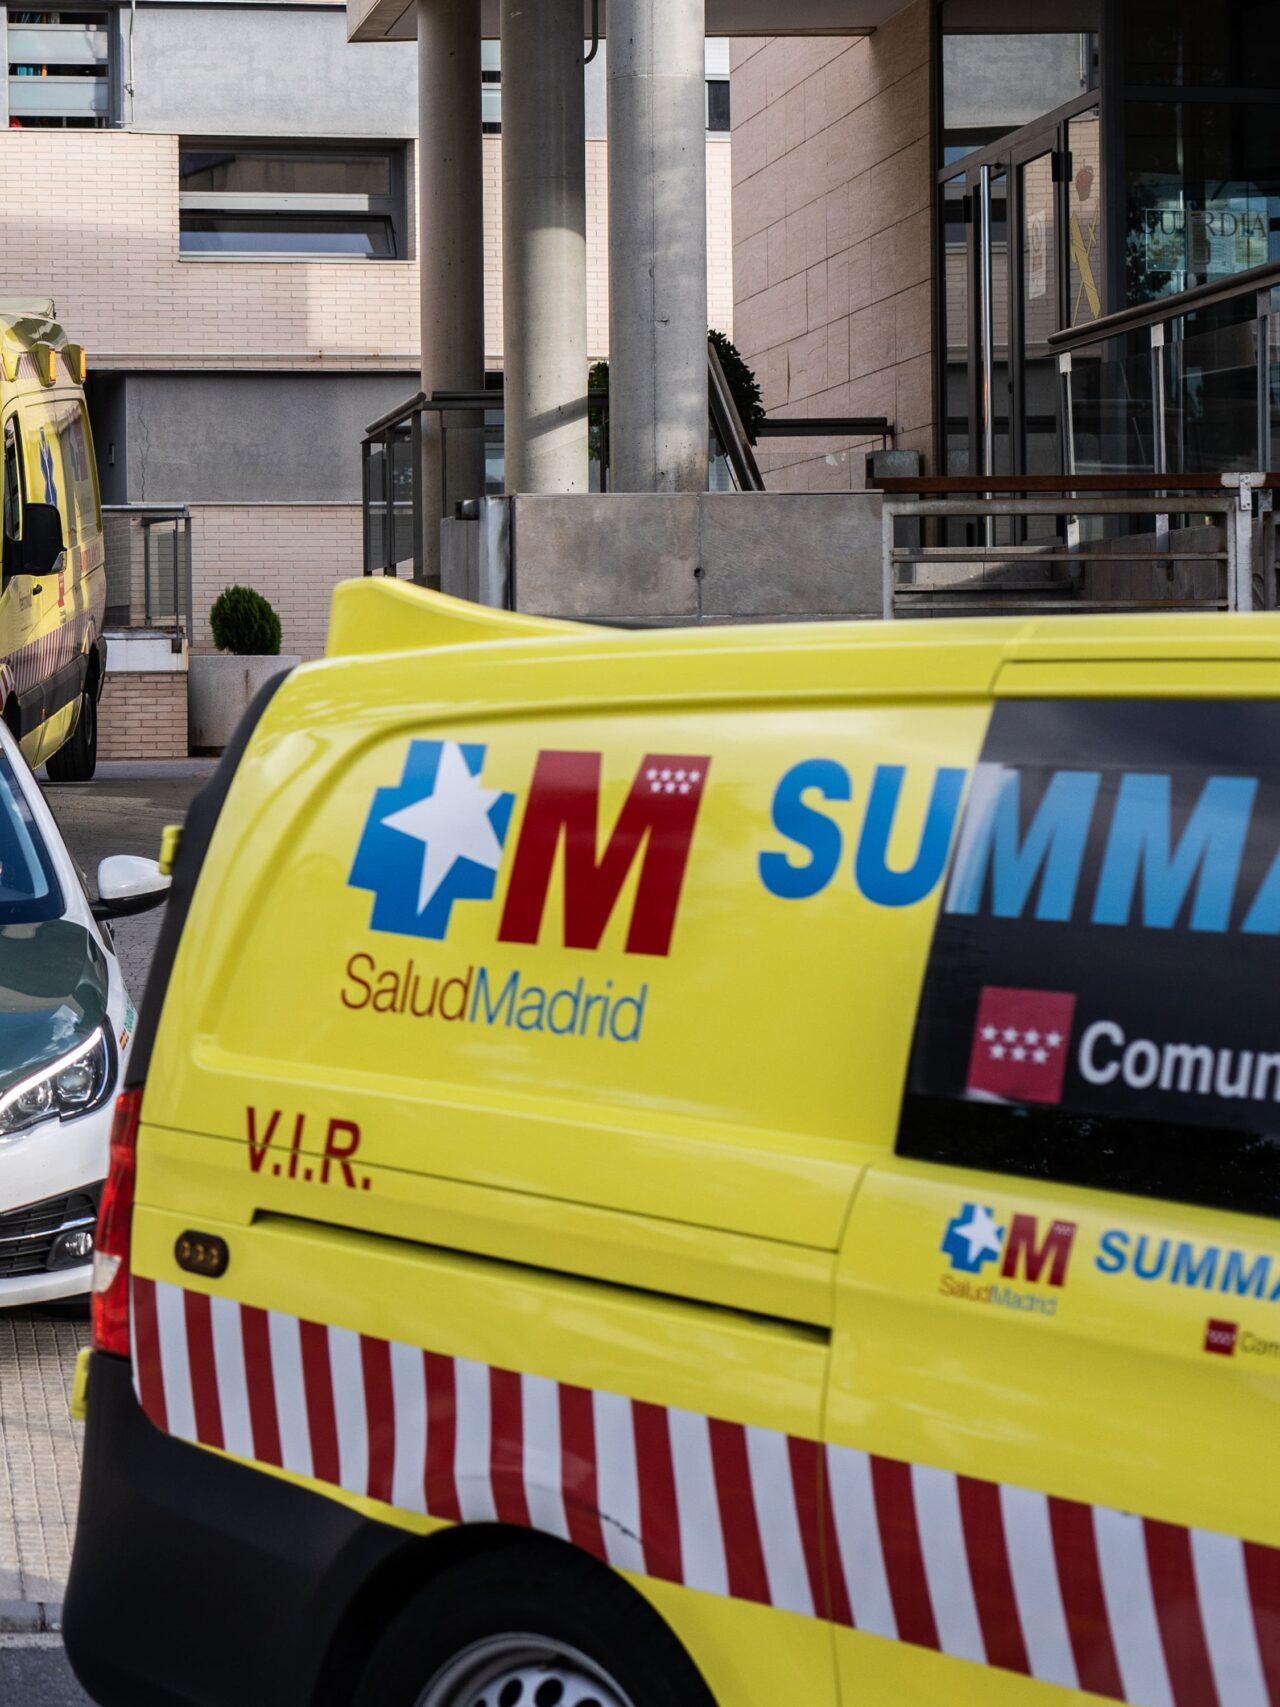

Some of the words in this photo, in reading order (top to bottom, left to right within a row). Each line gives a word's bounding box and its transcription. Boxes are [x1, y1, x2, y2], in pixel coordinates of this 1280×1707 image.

[1144, 209, 1268, 238] GURDIA
[340, 952, 649, 1043] SaludMadrid
[1078, 1019, 1280, 1102] Comun
[246, 1105, 372, 1191] V.I.R.
[938, 1274, 1058, 1317] SaludMadrid
[1094, 1229, 1280, 1303] SUMM
